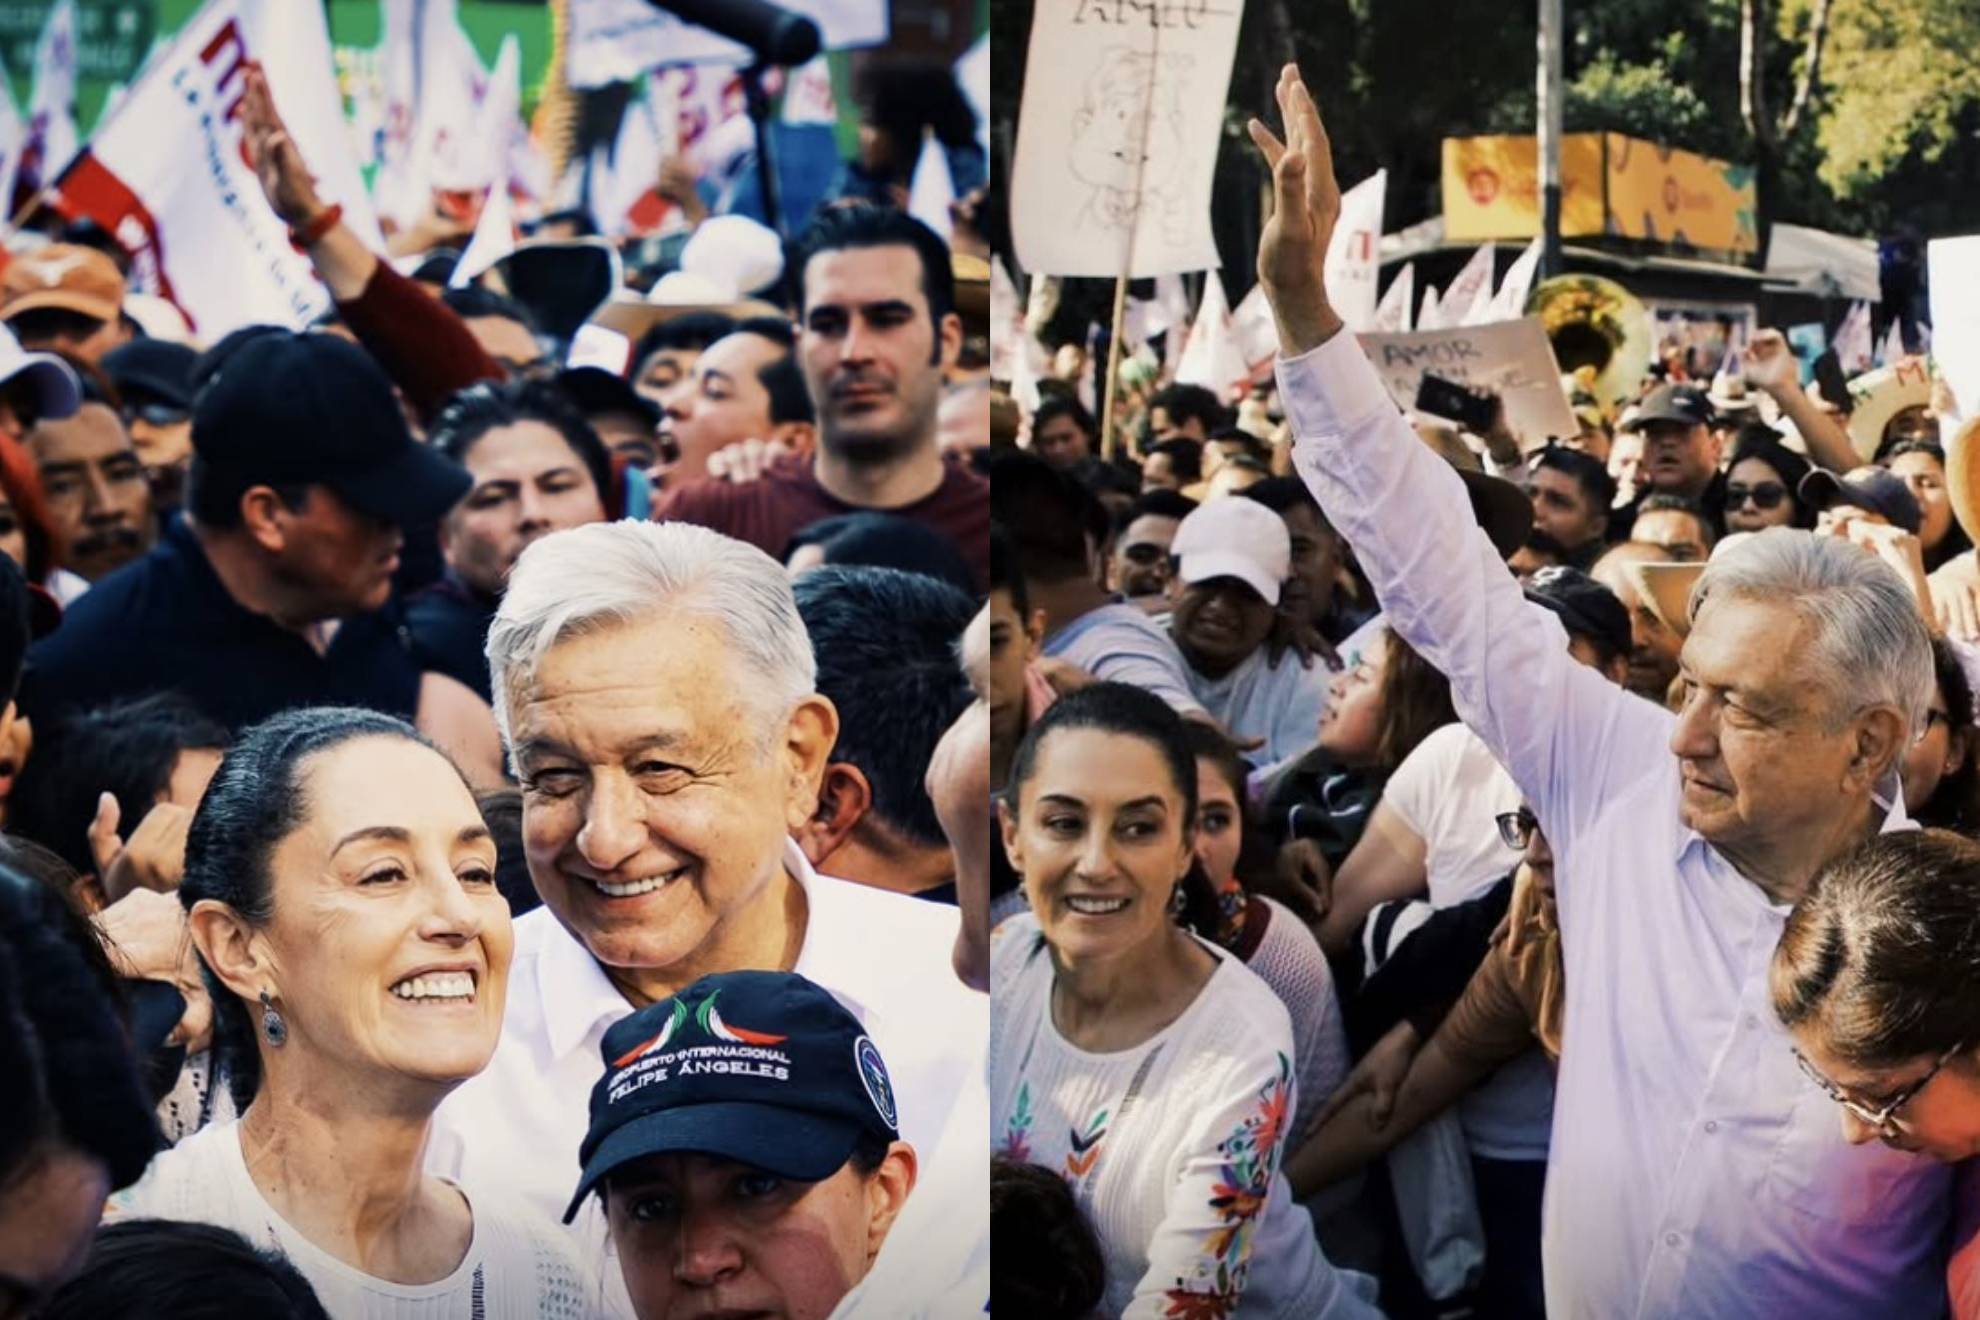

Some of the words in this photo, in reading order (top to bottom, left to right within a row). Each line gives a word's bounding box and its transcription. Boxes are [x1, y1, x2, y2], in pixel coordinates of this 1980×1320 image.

[676, 1045, 792, 1065] INTERNACIONAL
[608, 1068, 669, 1105] FELIPE
[678, 1059, 790, 1082] ÁNGELES
